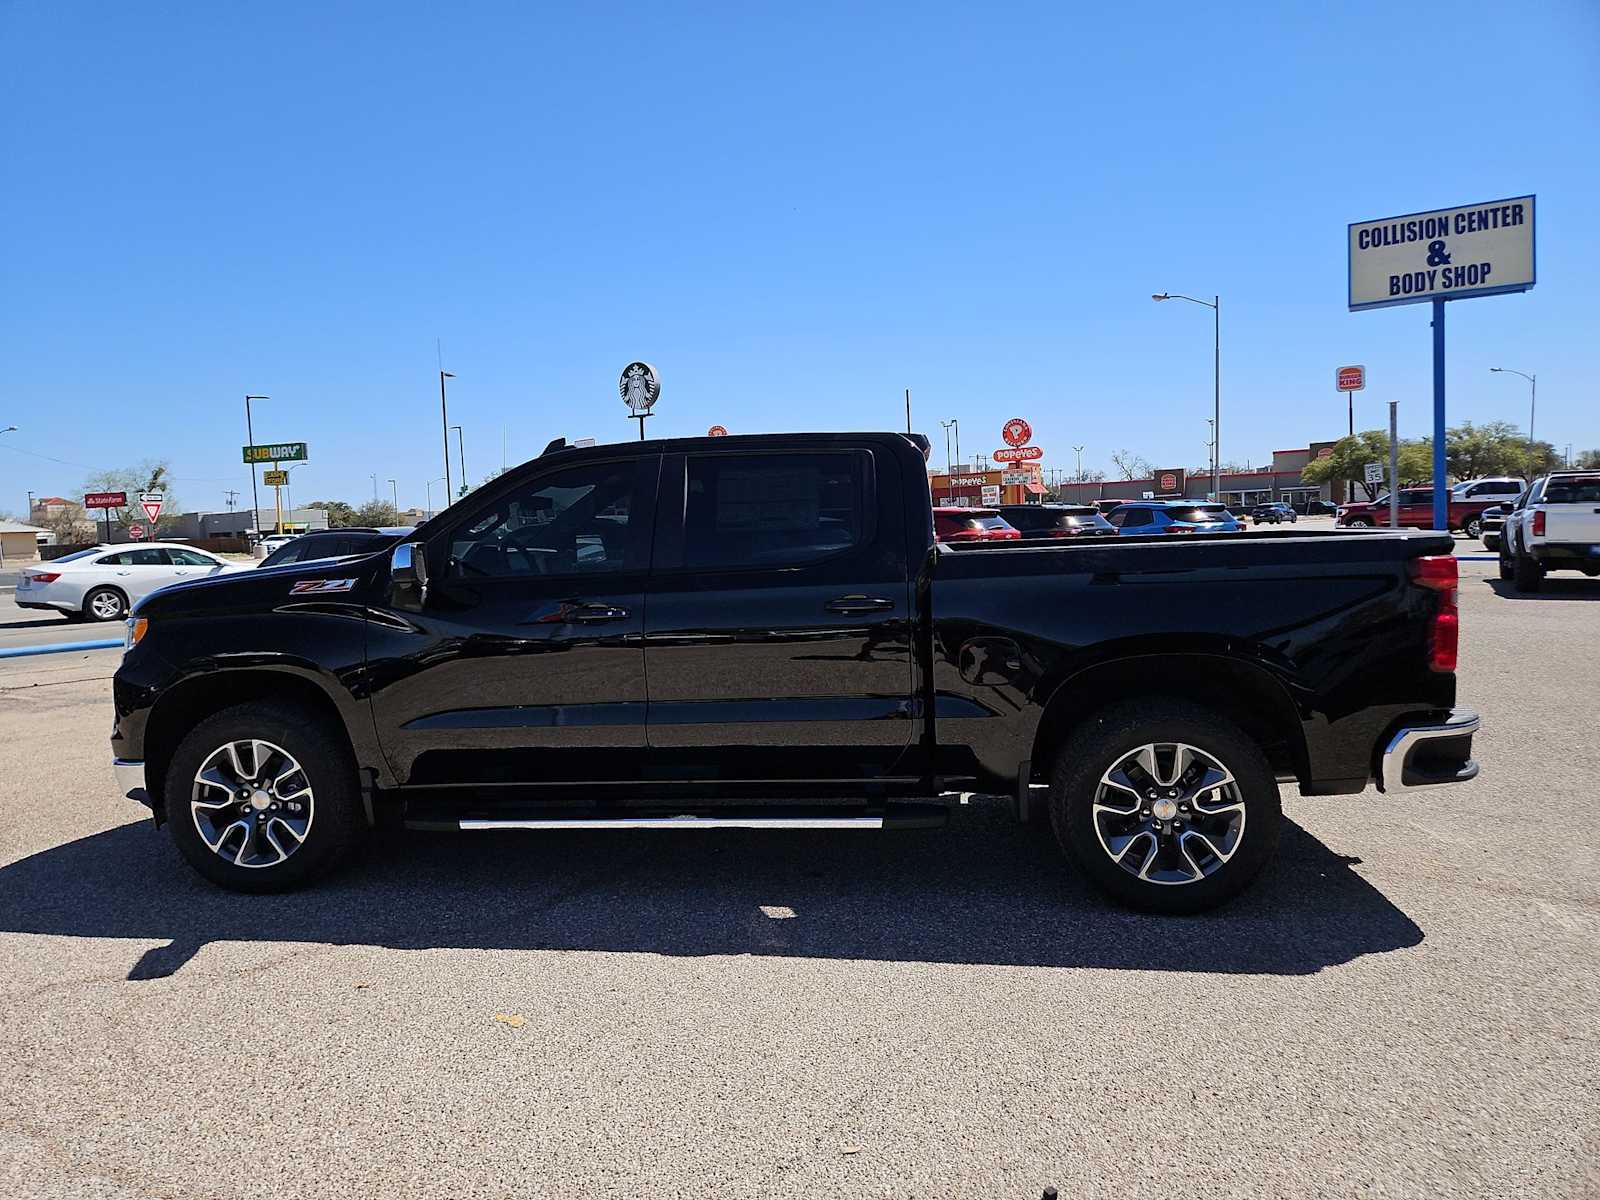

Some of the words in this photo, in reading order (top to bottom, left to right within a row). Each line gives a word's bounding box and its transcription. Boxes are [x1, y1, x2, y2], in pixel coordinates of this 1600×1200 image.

[1358, 216, 1449, 250] COLLISION
[1454, 204, 1524, 235] CENTER
[1426, 240, 1451, 267] &
[1389, 270, 1438, 296] BODY
[1441, 262, 1491, 289] SHOP
[245, 445, 300, 460] SUBWAY
[996, 448, 1037, 460] POPEYES
[1367, 473, 1382, 482] 35
